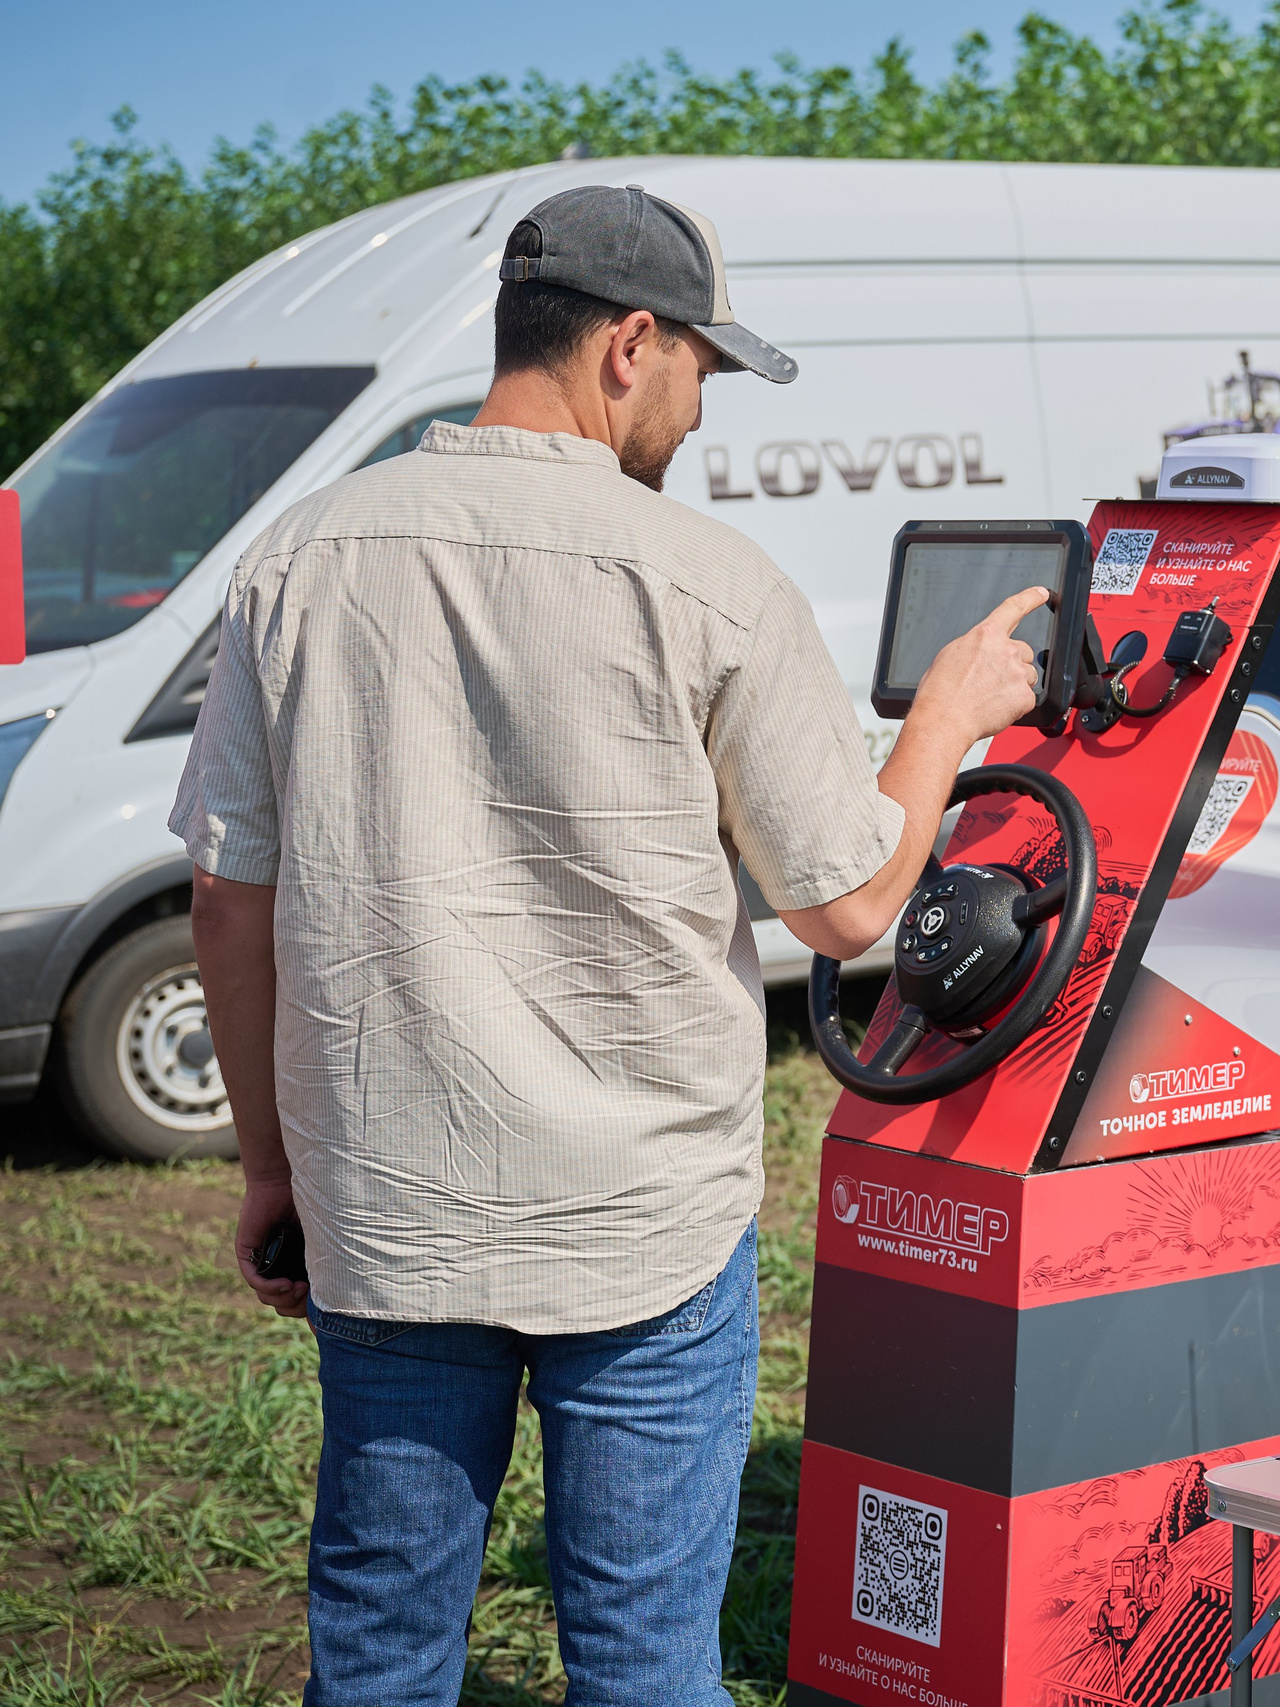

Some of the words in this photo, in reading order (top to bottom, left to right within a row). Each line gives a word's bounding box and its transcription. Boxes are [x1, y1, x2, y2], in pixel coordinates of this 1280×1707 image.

[704, 432, 1003, 500] LOVOL
[1196, 474, 1231, 485] ALLYNAV
[1156, 557, 1167, 569] И
[1166, 556, 1216, 571] УЗНАЙТЕ
[1216, 560, 1227, 571] О
[1227, 560, 1252, 572] НАС
[1162, 541, 1235, 555] СКАНИРУЙТЕ
[1149, 573, 1198, 586] БОЛЬШЕ
[952, 945, 985, 979] ALLYNAV
[1148, 1060, 1245, 1099] ТИМЕР
[1100, 1110, 1167, 1137] ТОЧНОЕ
[1171, 1094, 1272, 1126] ЗЕМЛЕДЕЛИЕ
[860, 1180, 1009, 1256] ТИМЕР
[857, 1233, 978, 1273] www.timer73.ru
[818, 1652, 828, 1668] И
[829, 1655, 879, 1686] УЗНАЙТЕ
[880, 1674, 891, 1690] О
[892, 1678, 917, 1699] НАС
[856, 1645, 931, 1684] СКАНИРУЙТЕ
